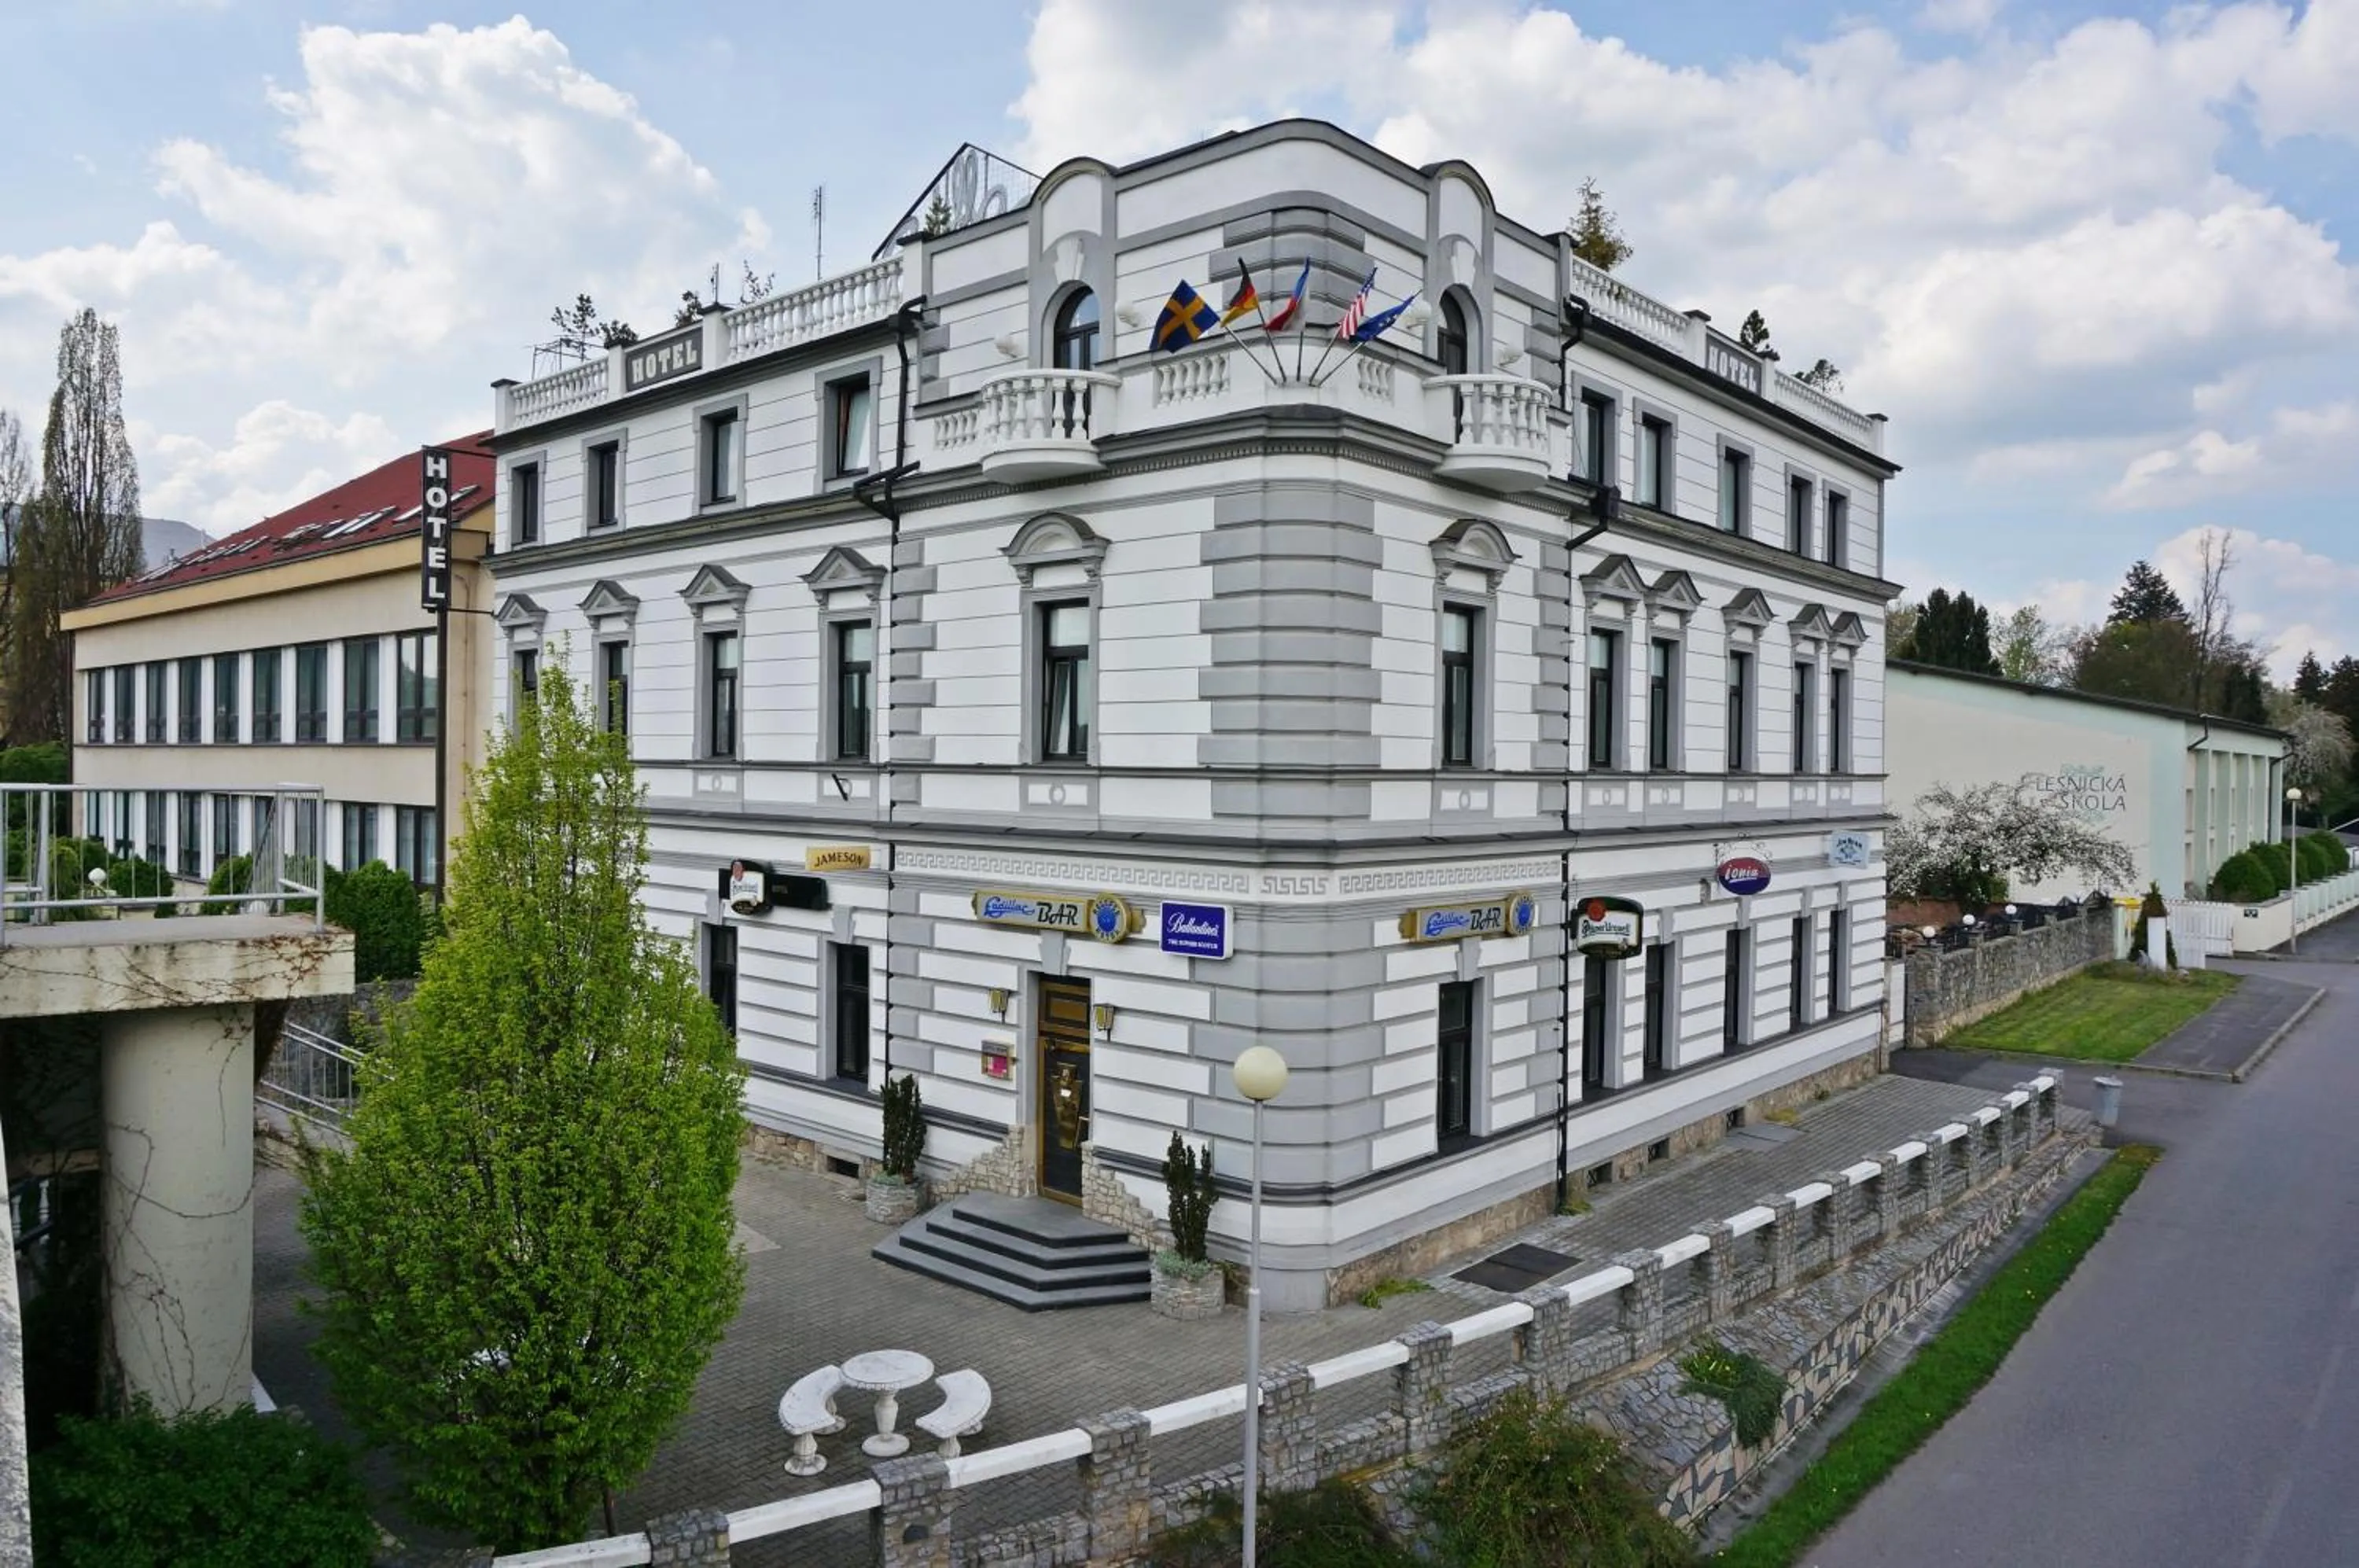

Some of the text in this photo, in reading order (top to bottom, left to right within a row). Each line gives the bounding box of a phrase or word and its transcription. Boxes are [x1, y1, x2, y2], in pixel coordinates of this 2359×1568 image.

[631, 339, 697, 384] HOTEL
[1708, 344, 1757, 393] HOTEL
[425, 456, 447, 599] HOTEL
[814, 852, 864, 867] JAMESON
